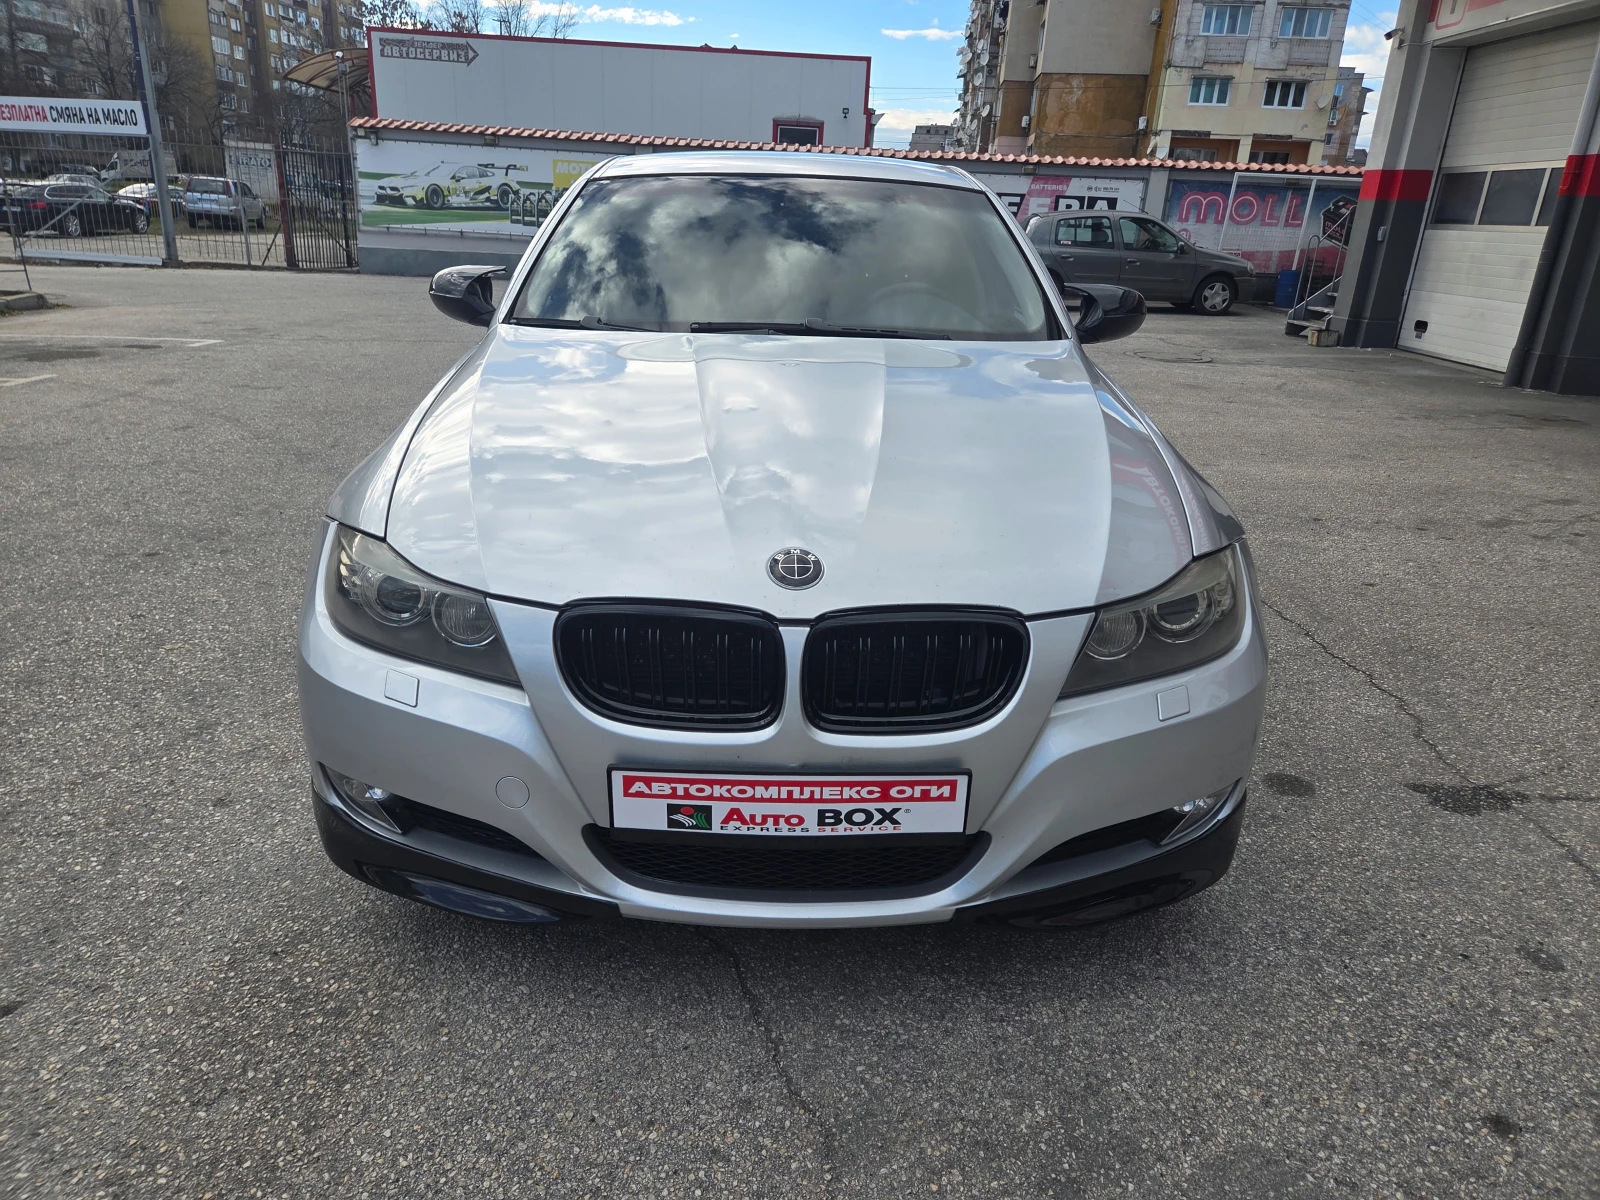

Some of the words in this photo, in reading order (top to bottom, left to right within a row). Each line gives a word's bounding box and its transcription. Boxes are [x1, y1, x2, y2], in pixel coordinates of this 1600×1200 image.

[384, 46, 466, 62] АВТОСЕРВИЗ
[0, 103, 49, 122] ЕЗПЛАТНА
[50, 105, 86, 124] СМЯНА
[87, 107, 101, 125] НА
[101, 107, 138, 126] МАСЛО
[774, 549, 818, 561] BMW
[628, 781, 881, 799] АВТОКОМПЛЕКС
[889, 785, 950, 799] ОГИ
[818, 825, 902, 833] SERVICE
